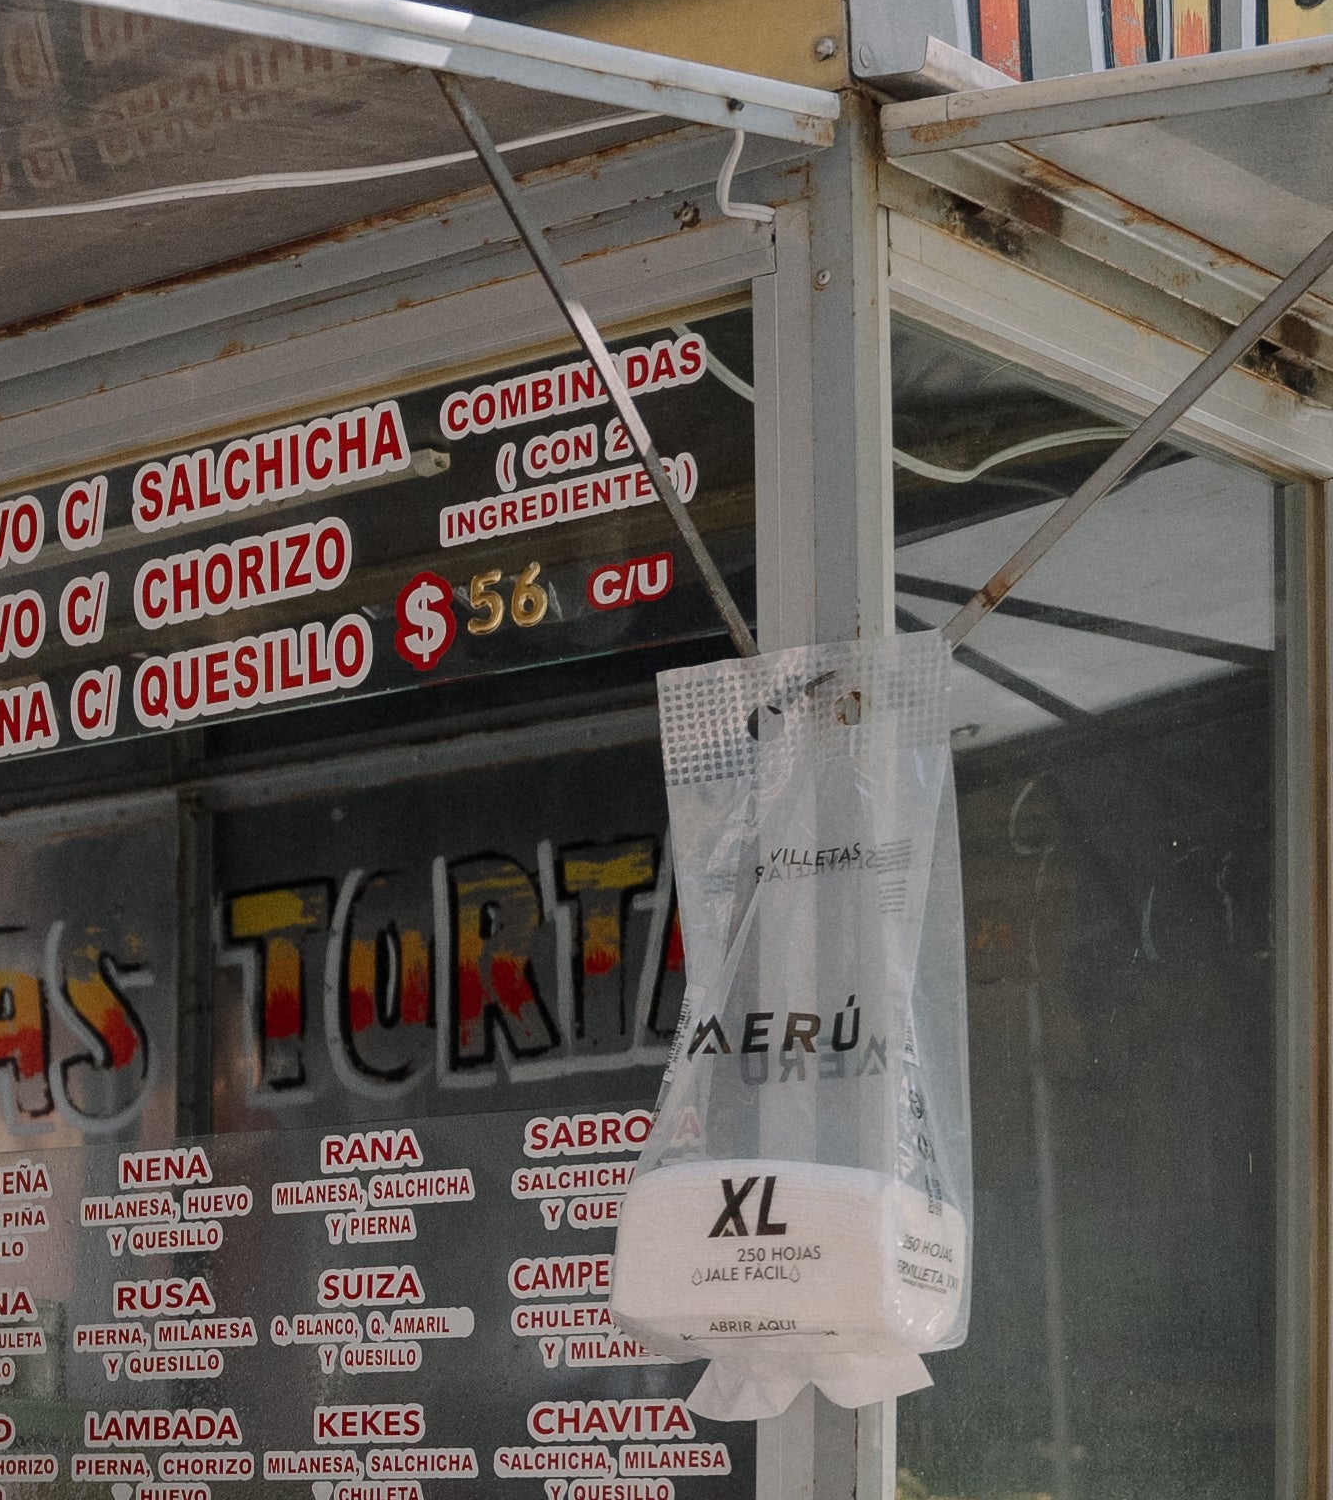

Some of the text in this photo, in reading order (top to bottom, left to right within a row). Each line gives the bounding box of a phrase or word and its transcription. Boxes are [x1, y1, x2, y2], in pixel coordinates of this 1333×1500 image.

[529, 432, 593, 471] CON
[63, 483, 102, 541] C/
[140, 410, 403, 522] SALCHICHA
[66, 578, 105, 637] C/
[142, 527, 345, 619] CHORIZO
[398, 557, 671, 666] $ 56 C/U
[76, 674, 115, 732] C/
[140, 624, 365, 717] QUESILLO
[530, 1107, 702, 1150] SABROA
[325, 1135, 419, 1166] RANA
[122, 1154, 208, 1183] NENA
[276, 1176, 471, 1206] MILANESA, SALCHICHA
[2, 1209, 47, 1229] PIÑA
[84, 1192, 250, 1221] MILANESA, HUEVO
[548, 1205, 560, 1222] Y
[707, 1176, 787, 1238] XL
[110, 1226, 220, 1251] Y QUESILLO
[330, 1215, 412, 1237] Y PIERNA
[738, 1246, 821, 1262] 250 HOJAS
[324, 1272, 420, 1301] SUIZA
[513, 1259, 610, 1293] CAMPE
[705, 1267, 738, 1282] JALE
[117, 1282, 211, 1311] RUSA
[76, 1321, 253, 1347] PIERNA, MILANESA
[273, 1318, 287, 1338] Q.
[295, 1317, 359, 1337] BLANCO,
[370, 1316, 386, 1336] Q.
[710, 1320, 796, 1332] ABRIR AQUI
[108, 1353, 221, 1375] Y QUESILLO
[324, 1347, 417, 1368] Y QUESILLO
[544, 1339, 663, 1361] Y MILANE
[88, 1414, 239, 1442] LAMBADA
[318, 1409, 421, 1438] KEKES
[532, 1404, 690, 1436] CHAVITA
[75, 1457, 254, 1476] PIERNA, CHORIZO
[267, 1453, 474, 1478] MILANESA, SALCHICHA
[499, 1449, 726, 1472] SALCHICHA, MILANESA
